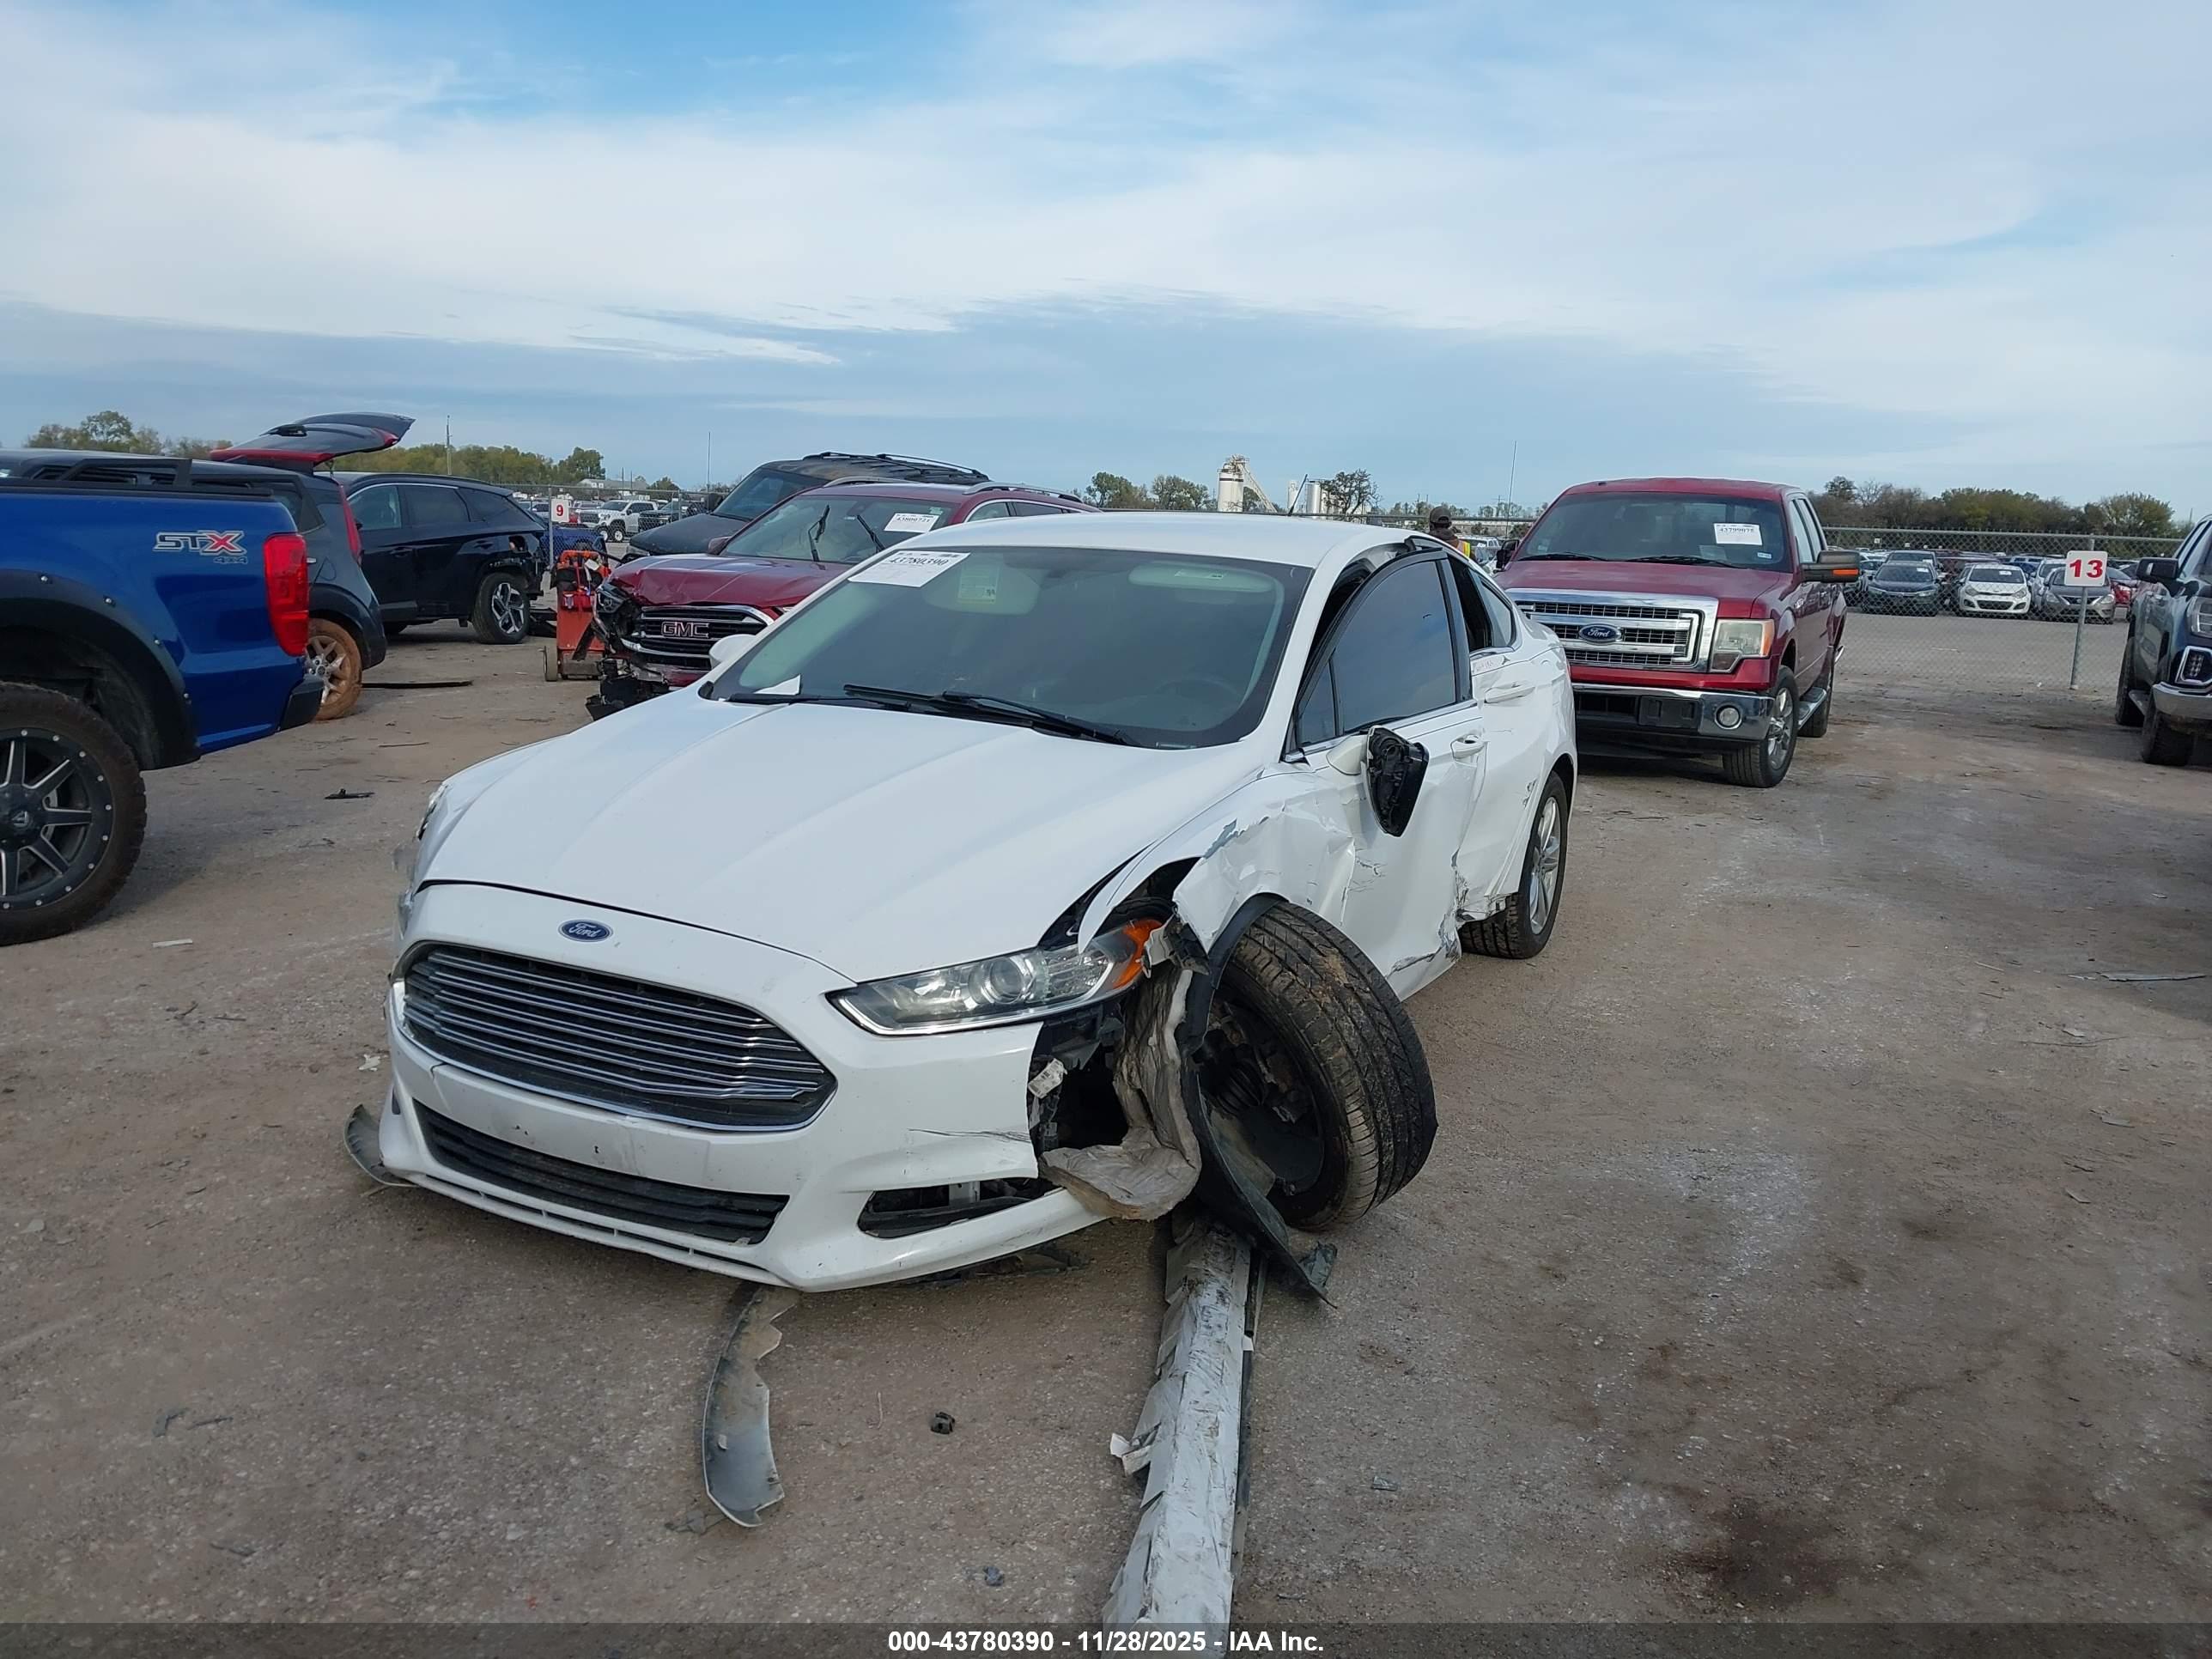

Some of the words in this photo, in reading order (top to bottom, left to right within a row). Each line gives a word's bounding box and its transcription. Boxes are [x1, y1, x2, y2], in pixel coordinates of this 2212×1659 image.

[556, 504, 564, 517] 9
[153, 530, 247, 555] STX
[2069, 559, 2103, 578] 13
[661, 621, 709, 638] GMC
[1588, 627, 1611, 637] Ford
[568, 922, 602, 938] Ford
